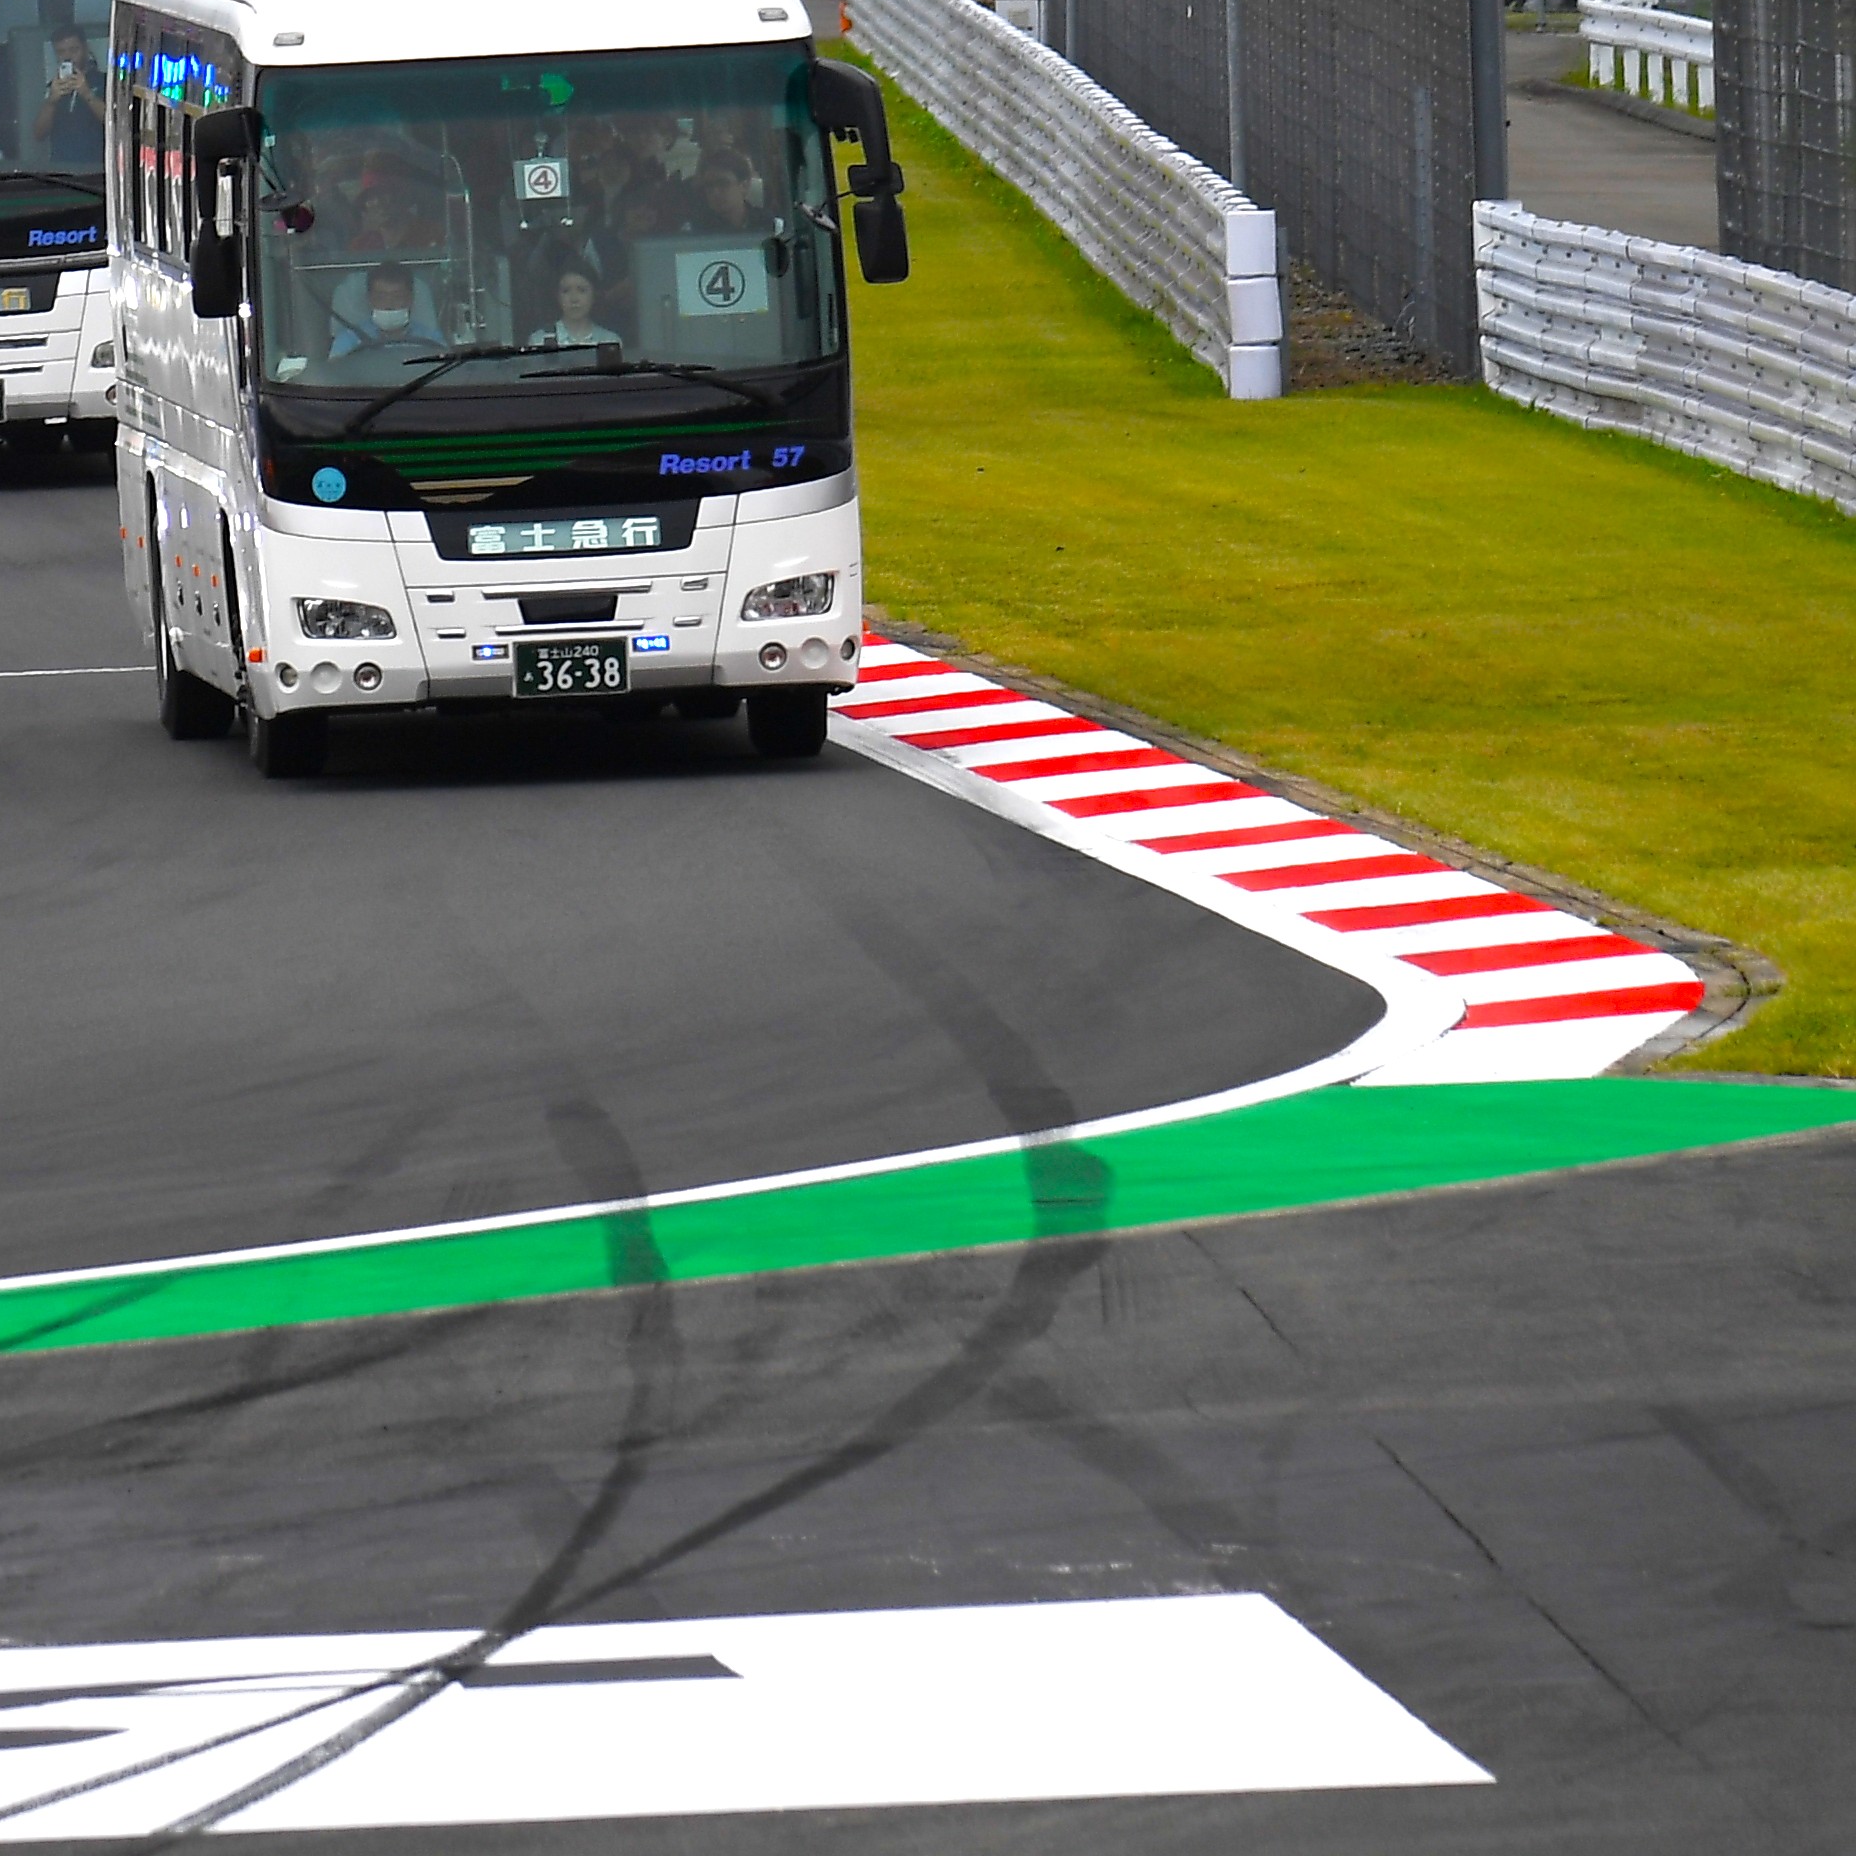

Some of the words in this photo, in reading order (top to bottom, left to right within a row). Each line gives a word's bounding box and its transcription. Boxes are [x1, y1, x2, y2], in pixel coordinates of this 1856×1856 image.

[28, 225, 97, 247] Resort
[659, 450, 751, 476] Resort
[772, 445, 805, 469] 57
[469, 517, 658, 555] 富士急行
[537, 645, 600, 659] 富士山240
[537, 657, 621, 691] 36-38
